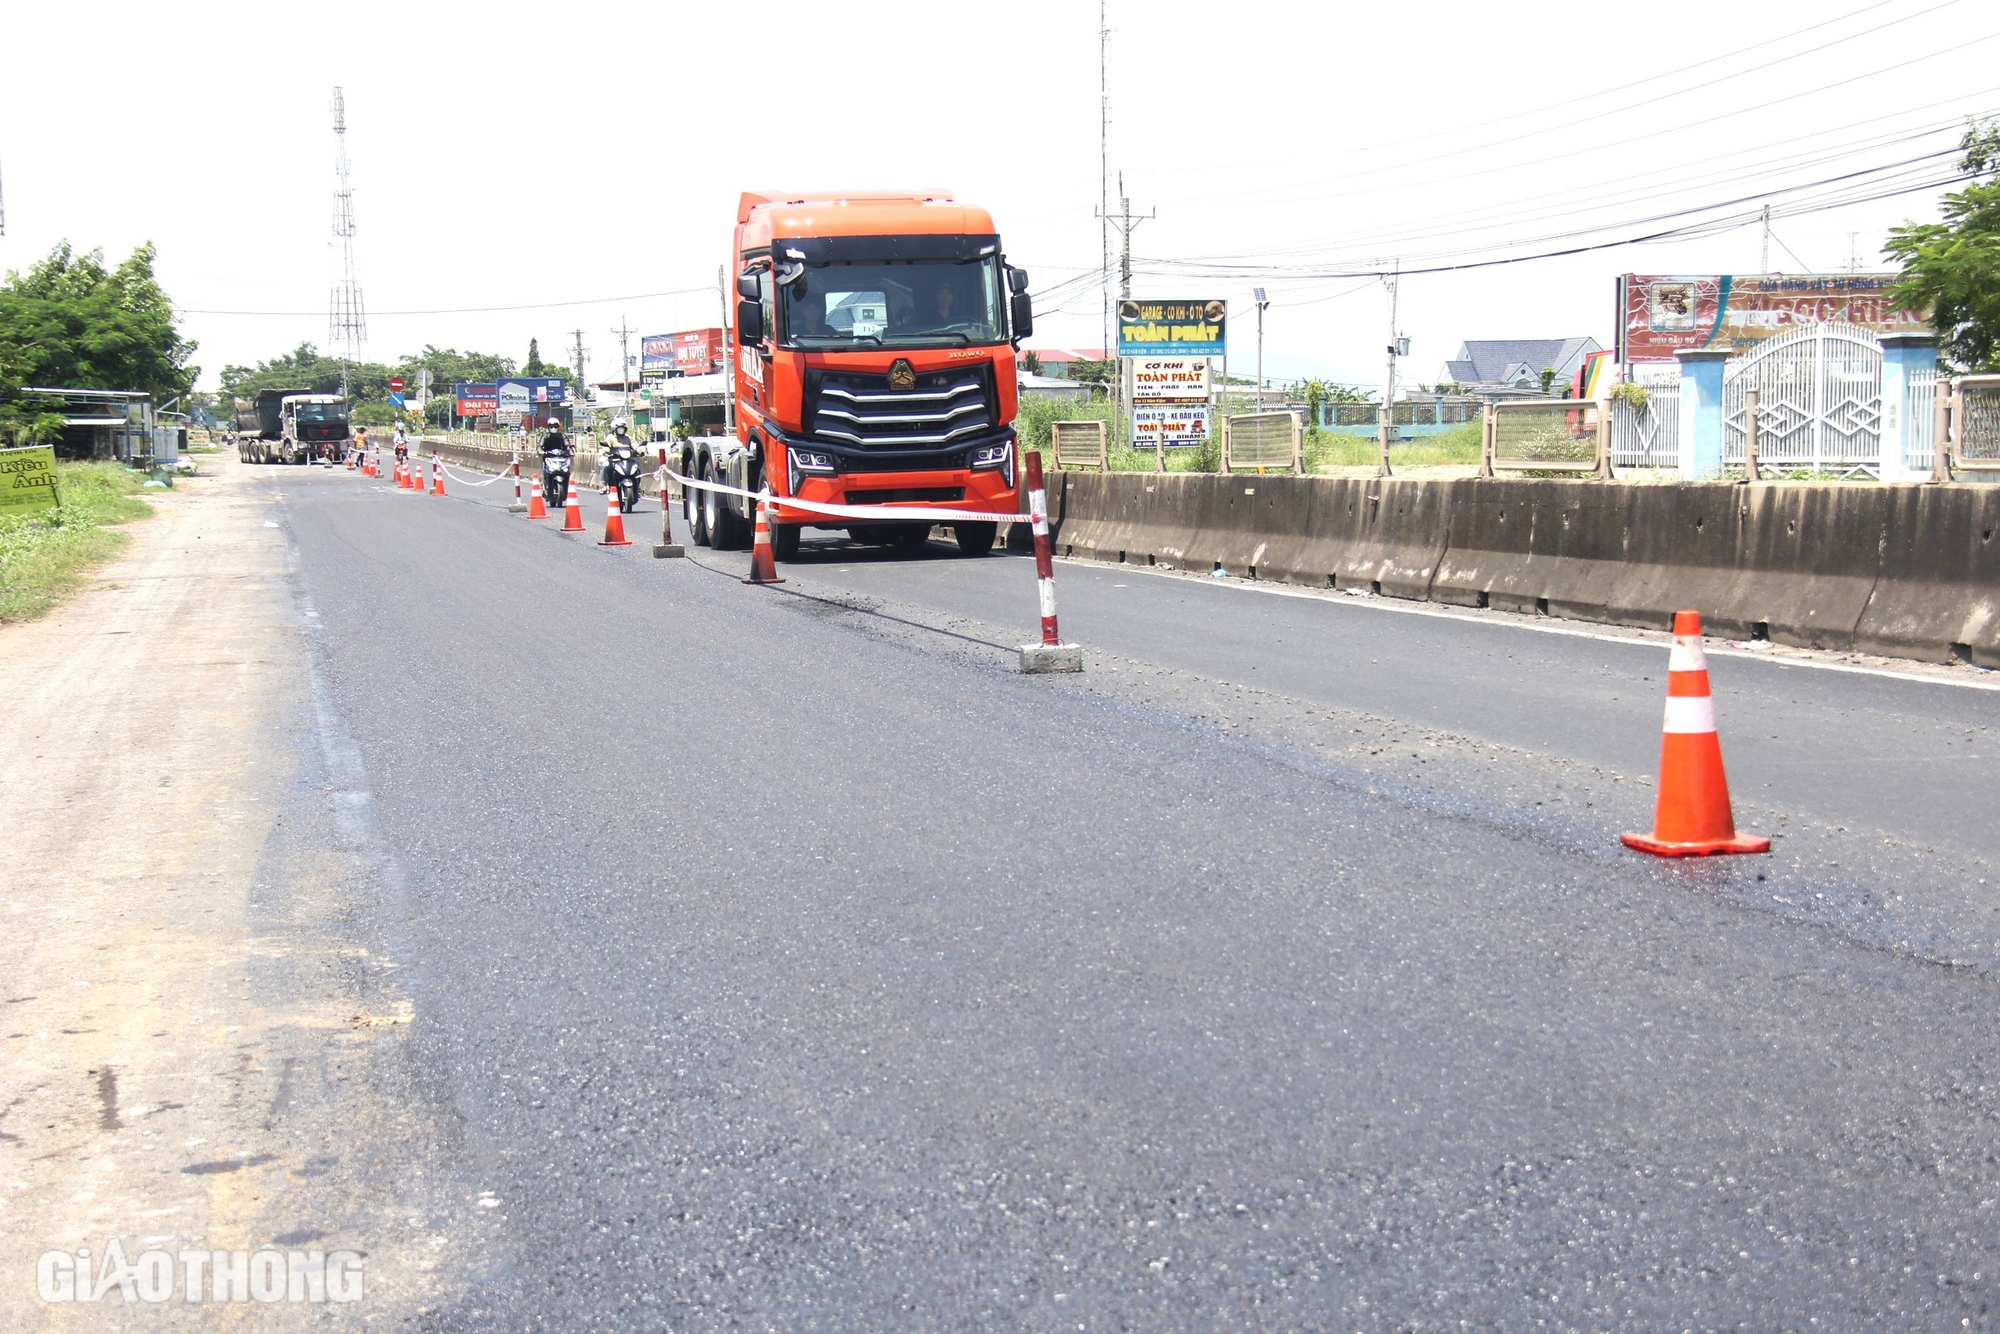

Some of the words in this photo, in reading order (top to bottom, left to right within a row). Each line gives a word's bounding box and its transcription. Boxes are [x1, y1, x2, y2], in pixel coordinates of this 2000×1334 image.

[1141, 305, 1163, 320] GARAGE
[1136, 371, 1168, 382] TOÀN
[1171, 371, 1202, 382] PHÁT
[1193, 411, 1205, 419] KÉO
[1, 458, 48, 474] Kiều
